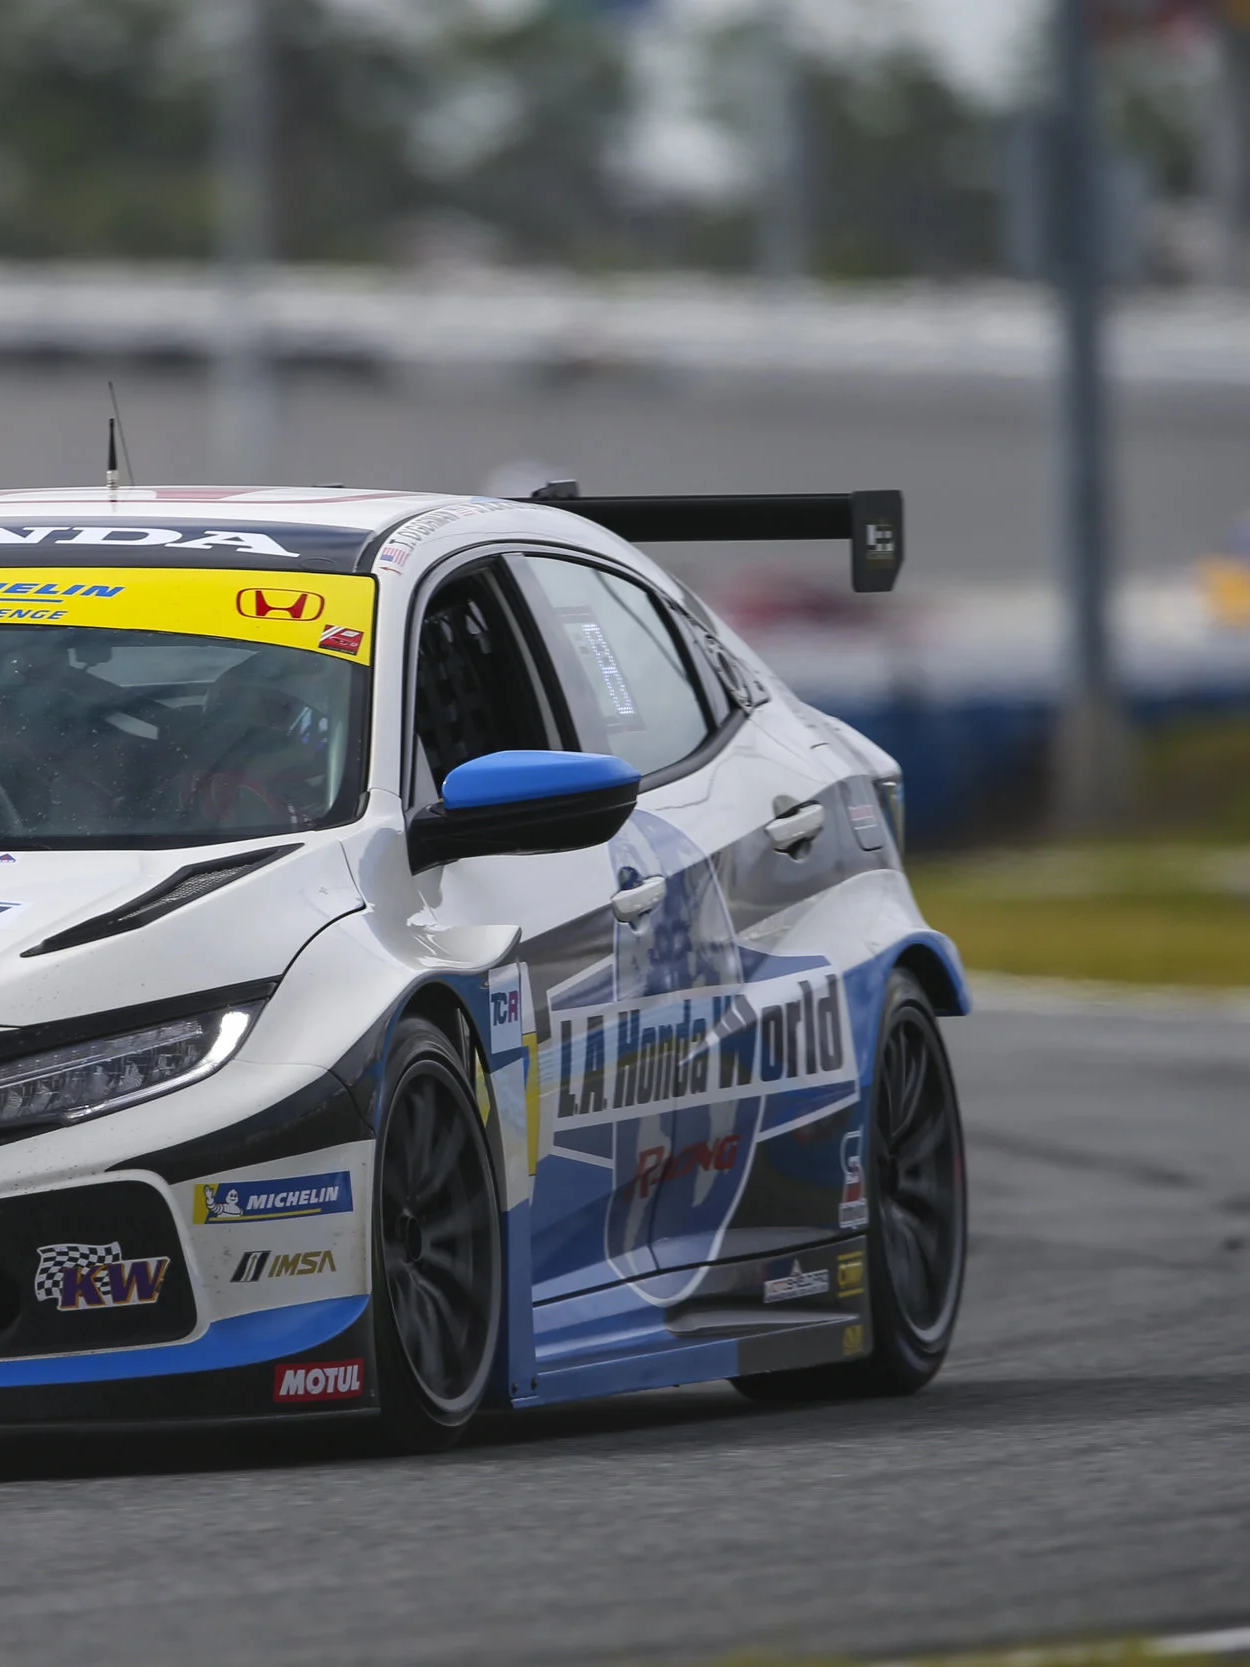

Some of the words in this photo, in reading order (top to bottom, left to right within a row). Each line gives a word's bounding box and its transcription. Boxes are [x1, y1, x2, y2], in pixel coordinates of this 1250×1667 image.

[490, 990, 519, 1026] TCR
[612, 999, 708, 1110] Honda
[713, 973, 845, 1090] World
[245, 1186, 340, 1210] MICHELIN
[267, 1250, 338, 1279] IMSA
[59, 1258, 170, 1309] KW
[278, 1364, 361, 1396] MOTUL
